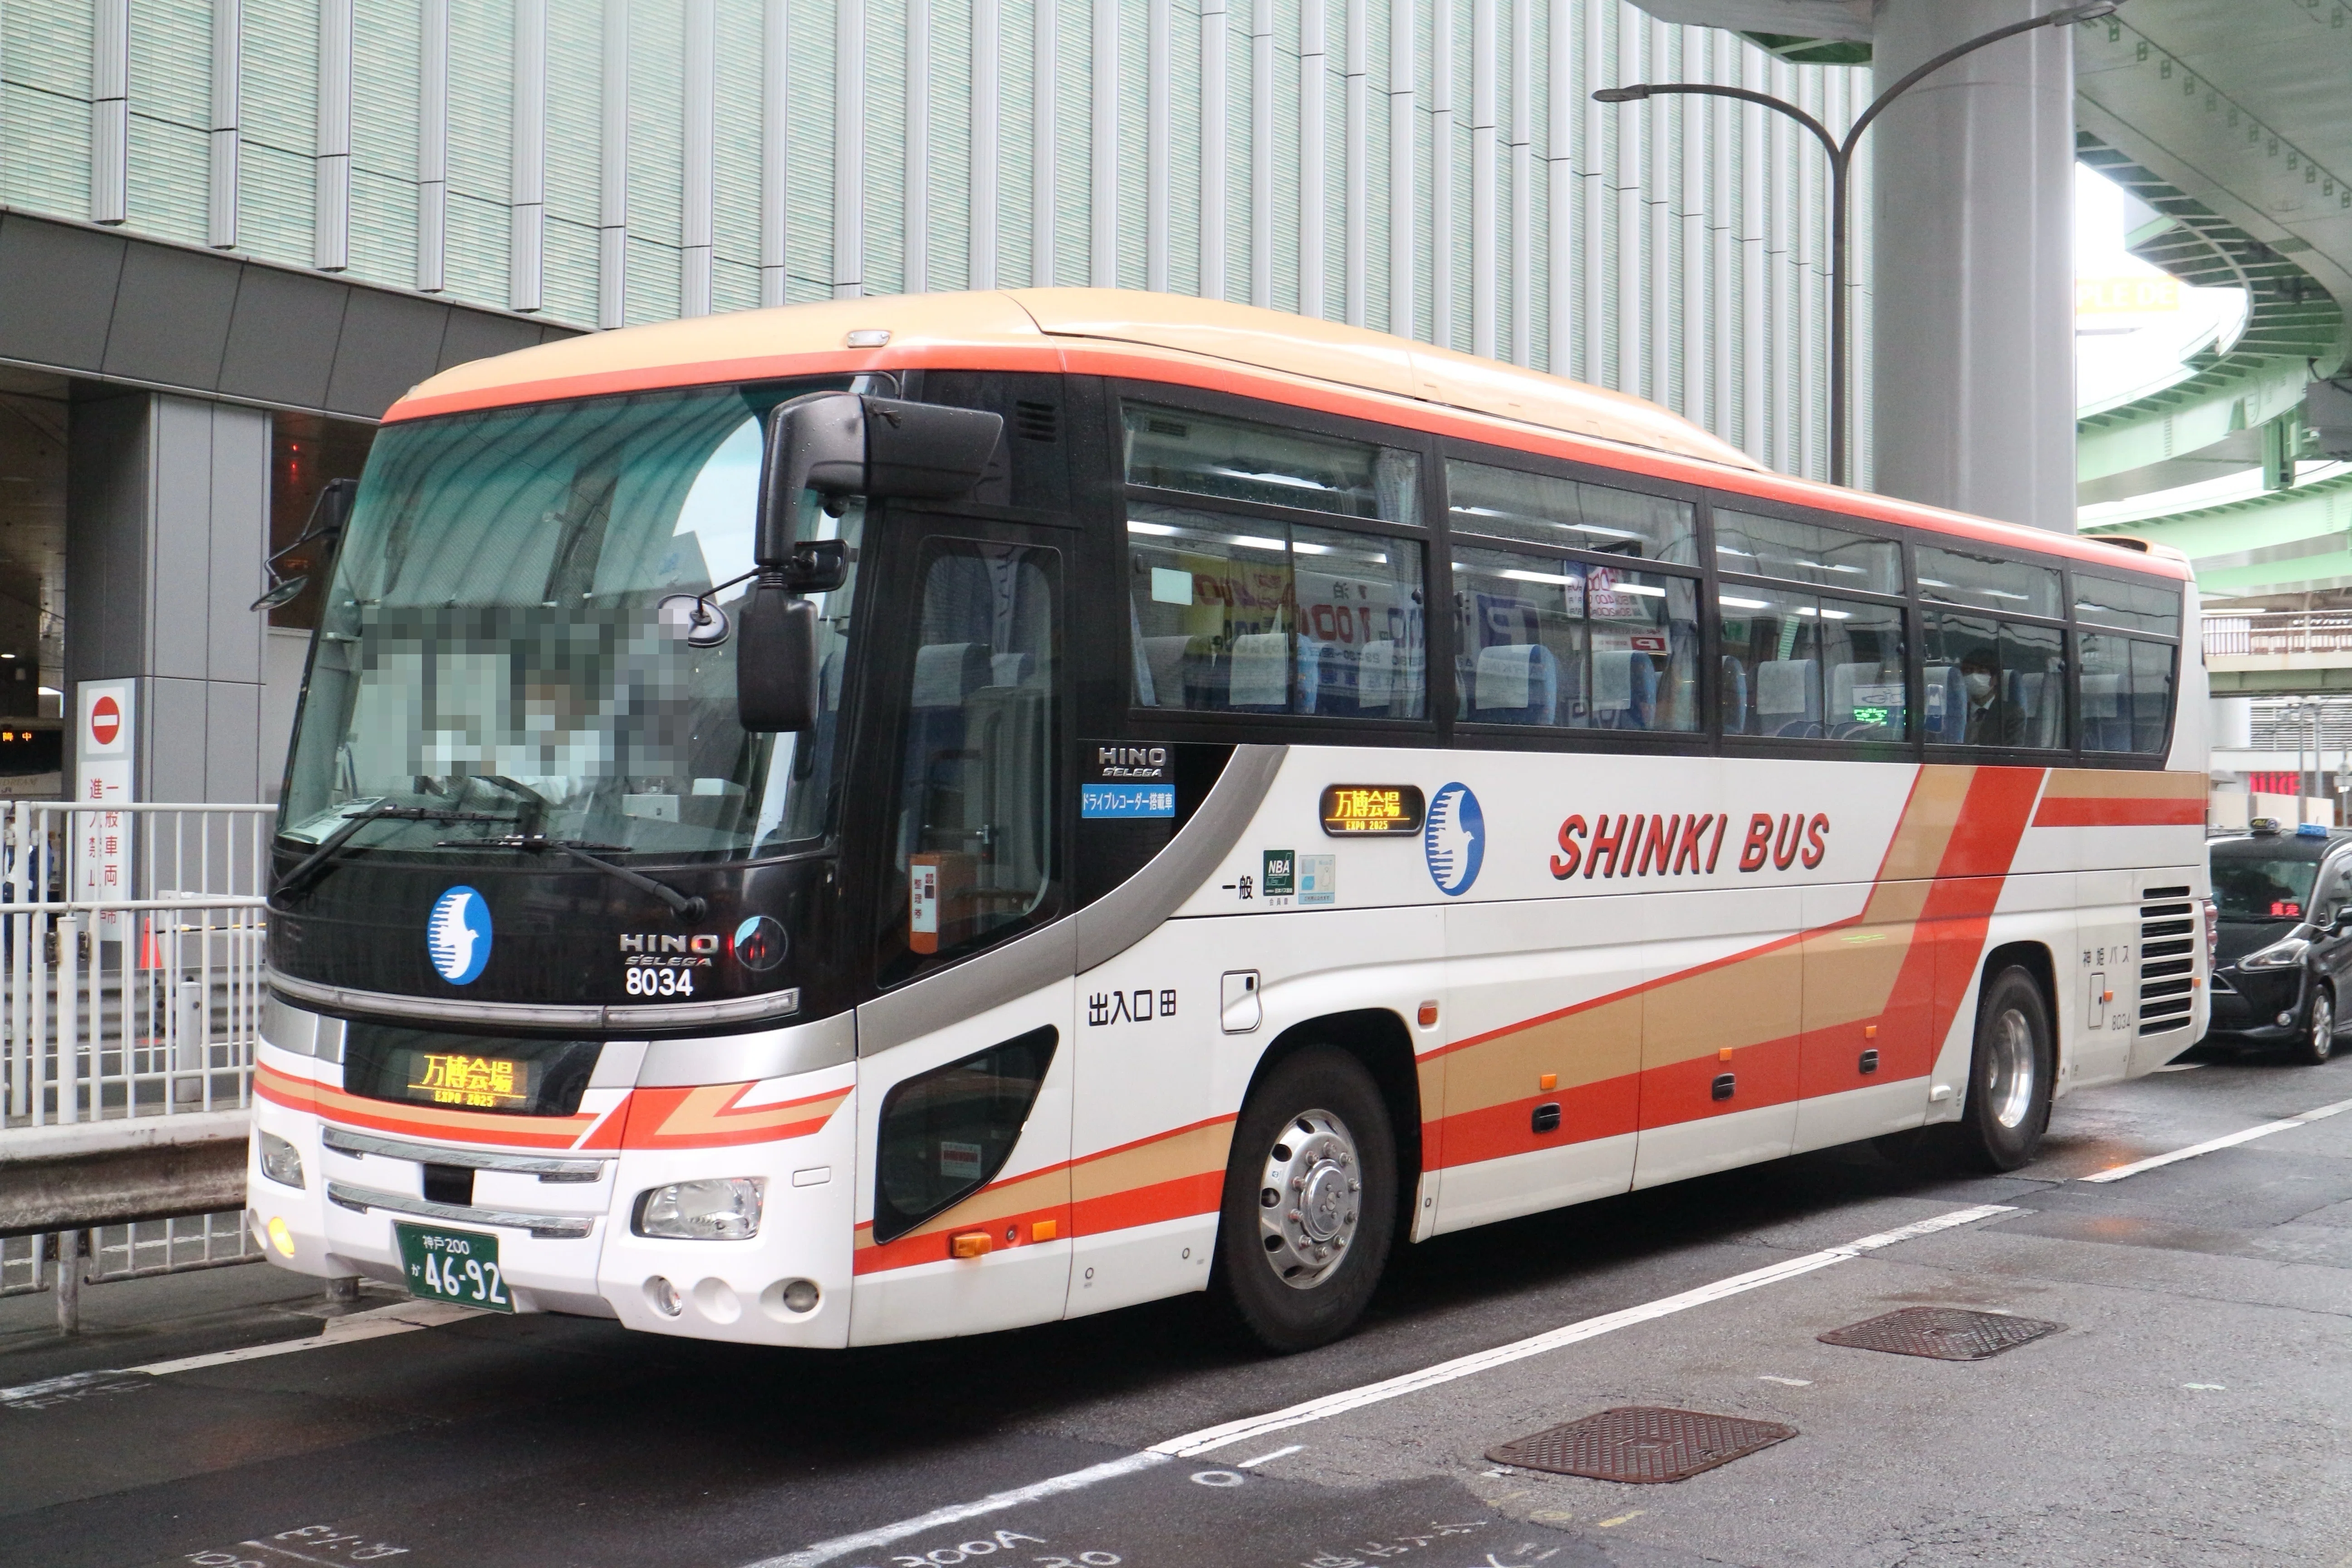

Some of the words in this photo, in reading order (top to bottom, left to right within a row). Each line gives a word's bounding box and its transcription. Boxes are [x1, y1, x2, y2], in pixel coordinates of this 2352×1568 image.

[1099, 747, 1166, 766] HINO
[1102, 766, 1162, 777] SELEGA
[1083, 792, 1173, 811] ドライブレコーダー搭載車
[1335, 790, 1401, 817] 万博会場
[1346, 820, 1365, 830] EXPO
[1369, 820, 1388, 830] 2025
[1549, 813, 1728, 881] SHINKI
[1739, 813, 1830, 873] BUS
[1268, 860, 1290, 873] NBA
[1222, 875, 1253, 899] 一般
[619, 933, 719, 954] HINO
[624, 954, 713, 967] SELEGA
[2083, 946, 2130, 968] 神姫バス
[625, 967, 694, 996] 8034
[1089, 989, 1153, 1026] 出入口
[2112, 1013, 2131, 1031] 8034
[421, 1055, 514, 1093] 万博会場
[434, 1090, 462, 1104] EXPO
[466, 1093, 495, 1107] 2025
[425, 1253, 507, 1304] 46-92
